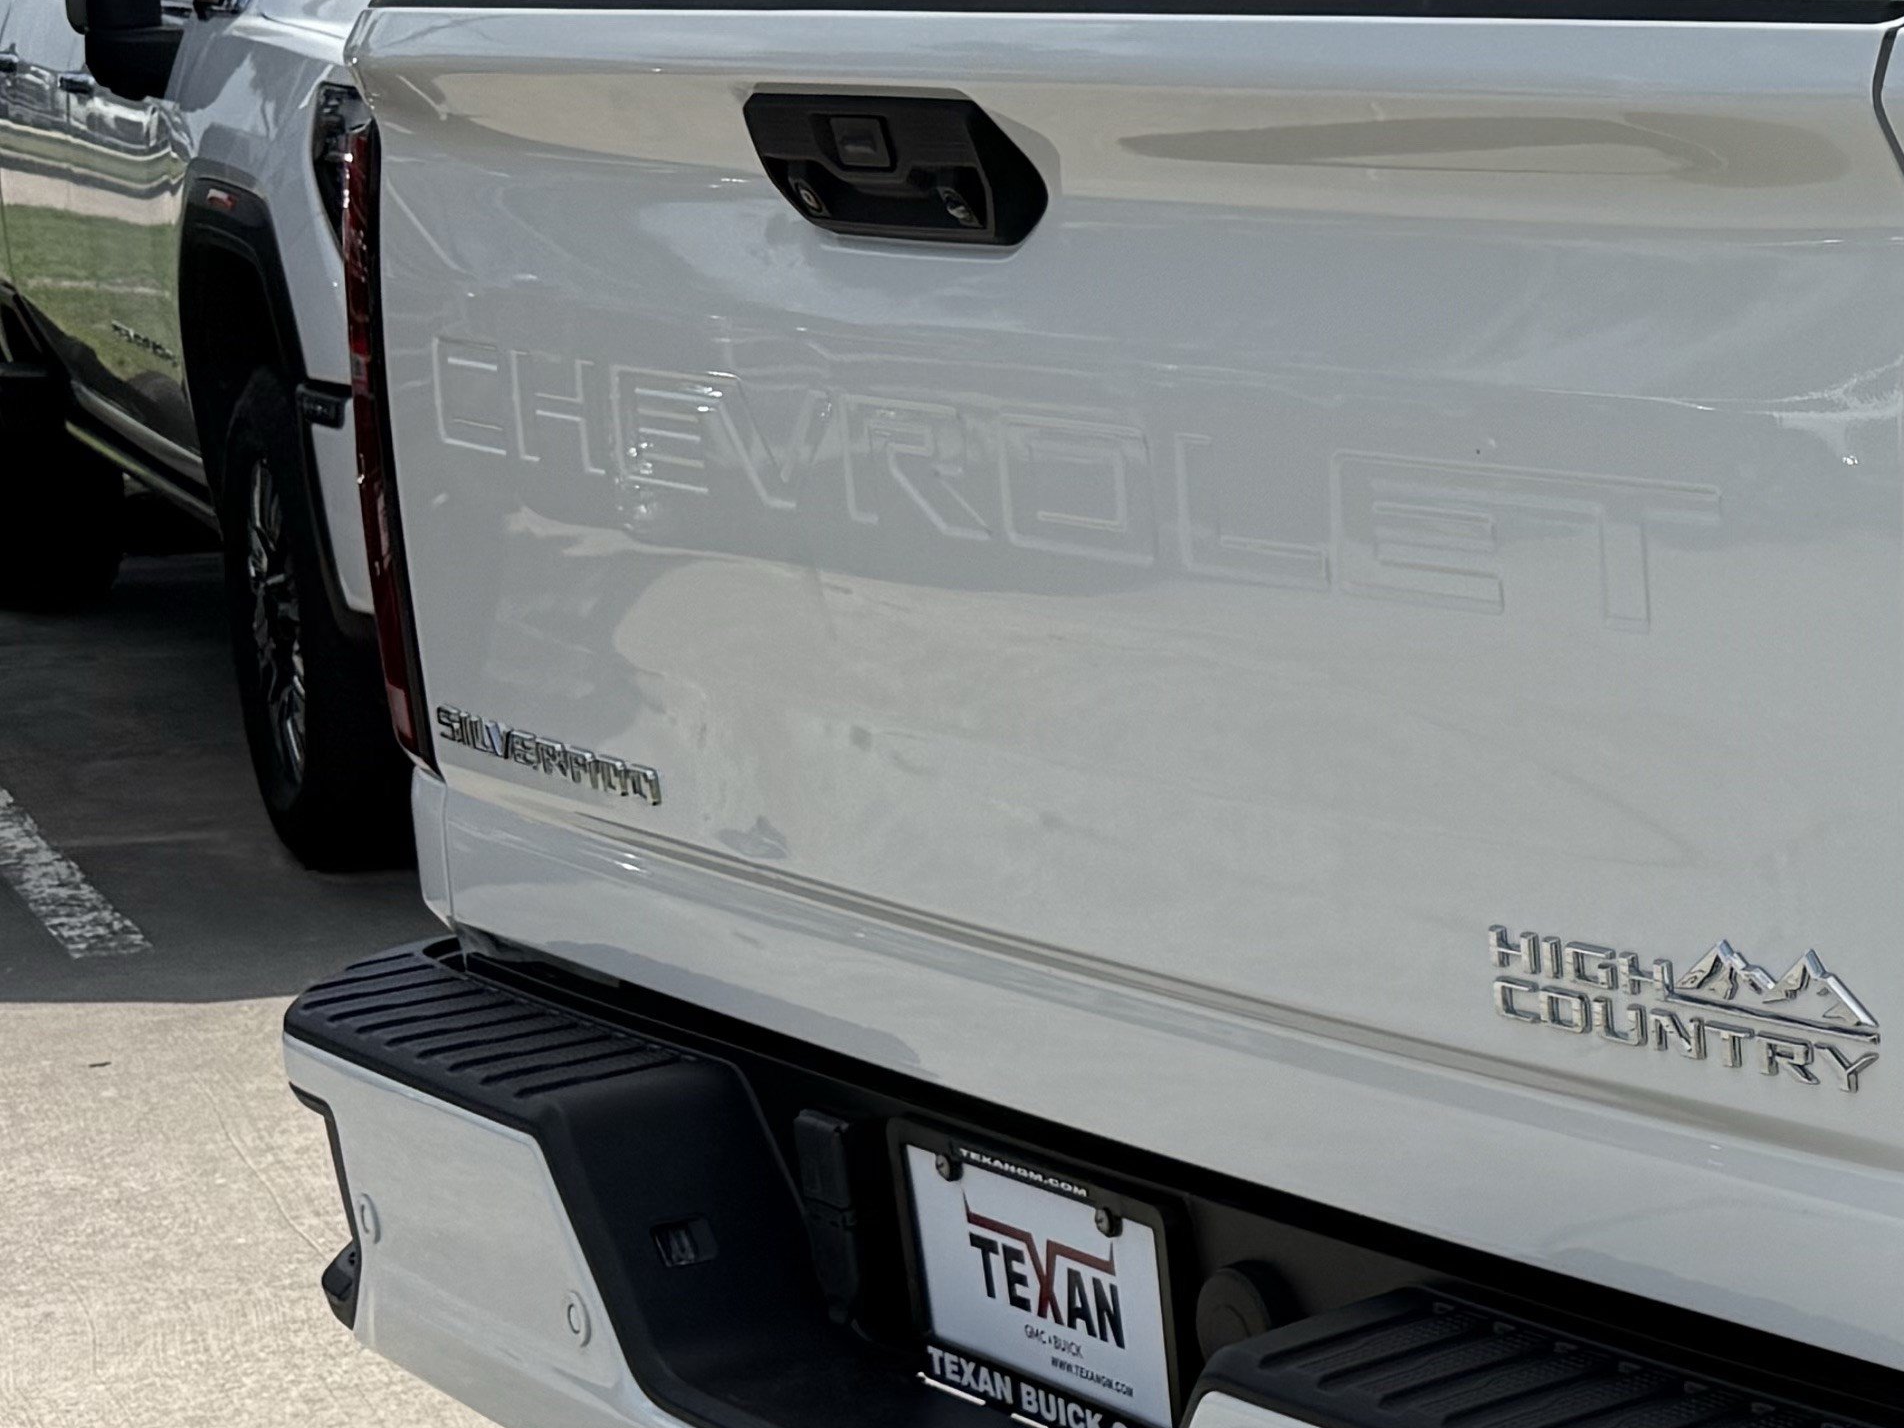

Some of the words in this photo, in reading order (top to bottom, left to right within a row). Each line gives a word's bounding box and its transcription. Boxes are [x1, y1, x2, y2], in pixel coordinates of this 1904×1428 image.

[431, 335, 1723, 633] CHEVROLET
[436, 702, 662, 806] SILVERADO
[1488, 923, 1674, 1002] HIGH
[1493, 975, 1880, 1093] COUNTRY
[959, 1147, 1088, 1197] TEXANGM.COM
[965, 1212, 1126, 1350] TEXAN
[927, 1345, 1014, 1405] TEXAN
